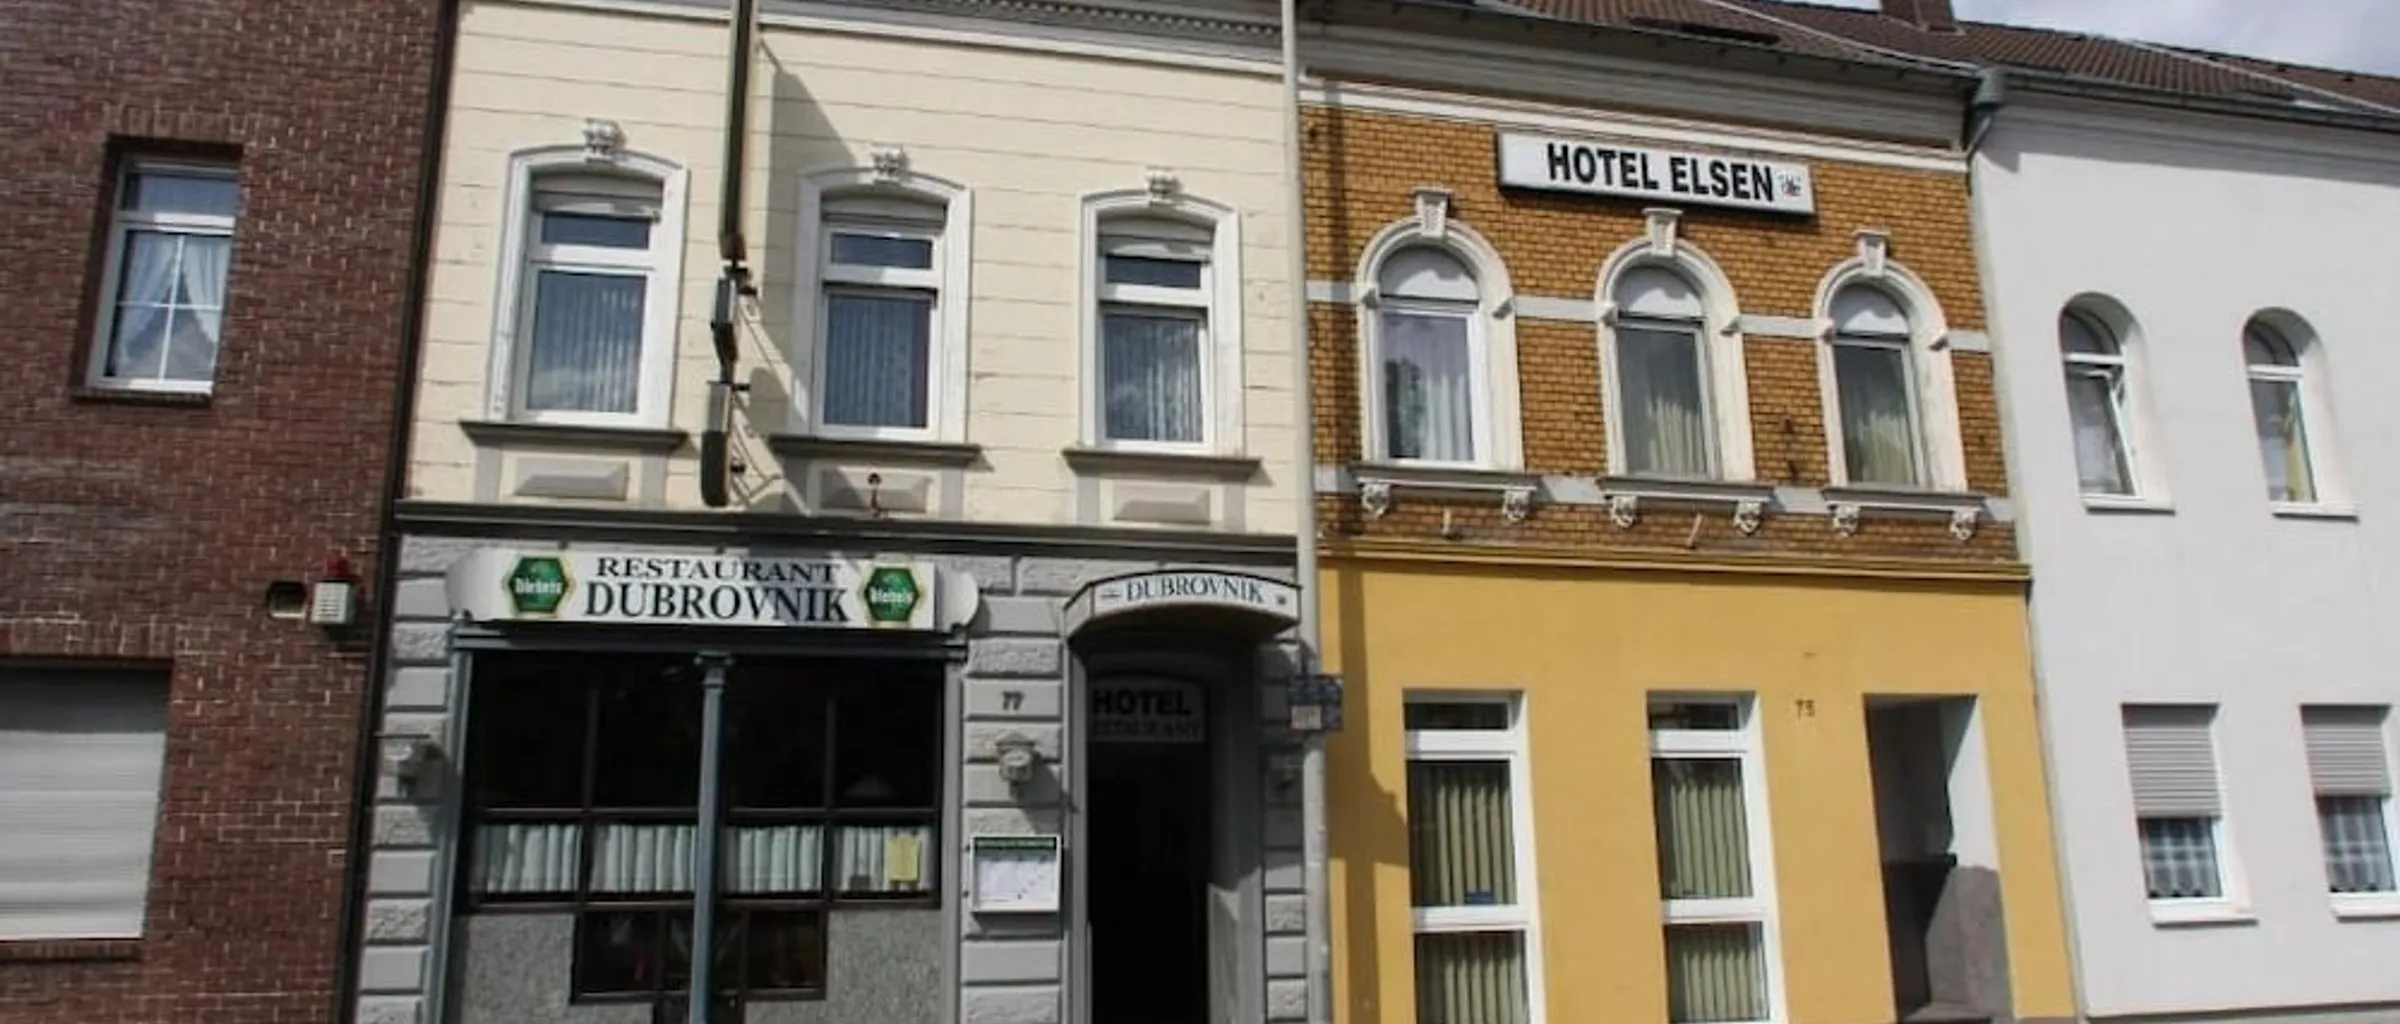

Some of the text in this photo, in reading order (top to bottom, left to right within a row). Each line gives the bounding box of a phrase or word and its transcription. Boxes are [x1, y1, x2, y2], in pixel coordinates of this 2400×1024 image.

[1547, 143, 1774, 202] HOTEL ELSEN
[596, 556, 842, 583] RESTAURANT
[585, 581, 850, 623] DUBROVNIK
[1126, 576, 1266, 604] DUBROVNIK
[1092, 688, 1193, 717] HOTEL
